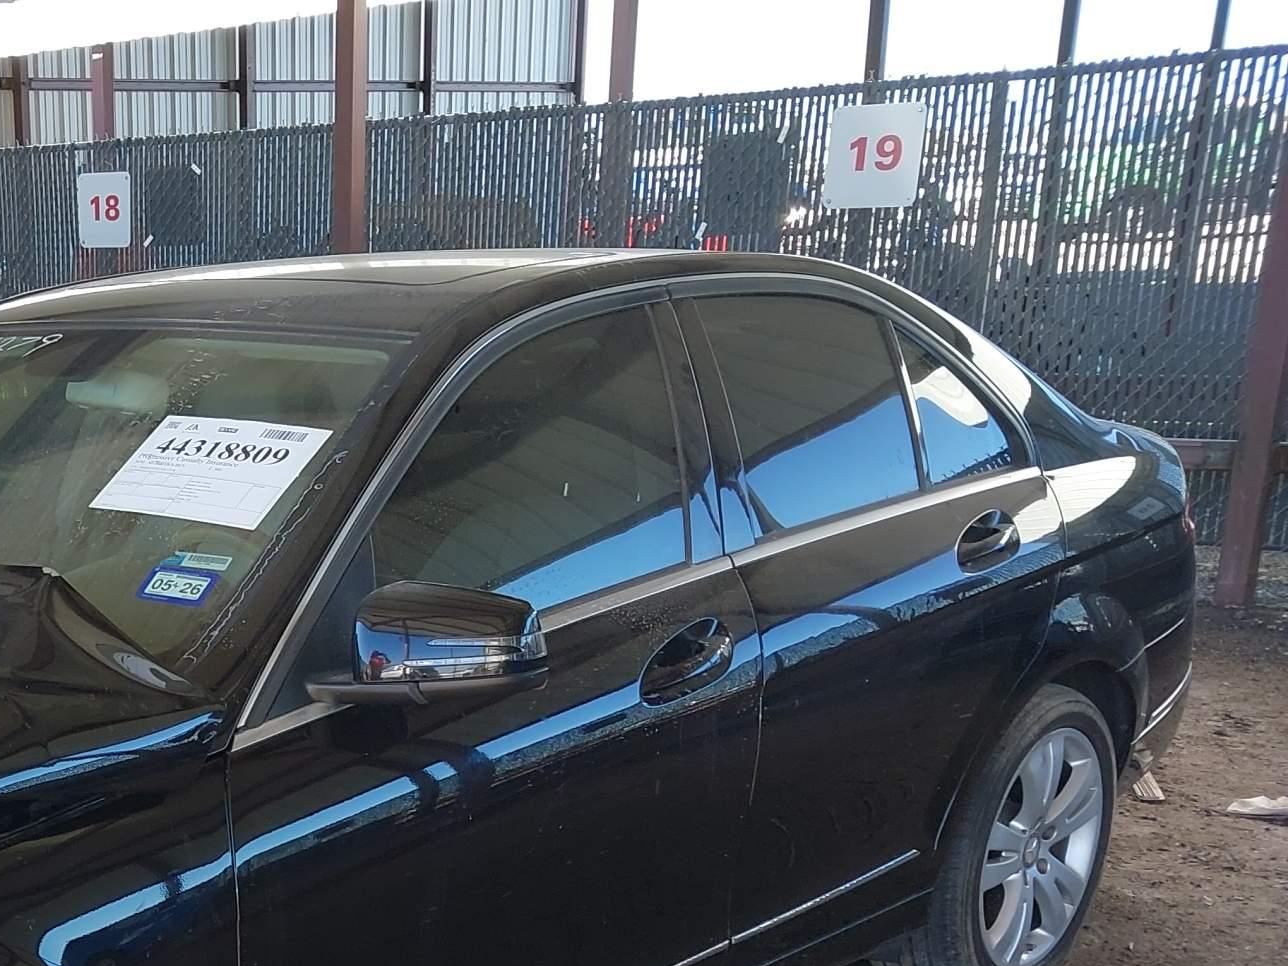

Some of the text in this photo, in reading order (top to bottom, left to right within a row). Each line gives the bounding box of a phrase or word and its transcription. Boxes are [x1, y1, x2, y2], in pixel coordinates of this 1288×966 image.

[849, 134, 903, 172] 19
[90, 194, 120, 221] 18
[156, 437, 291, 466] 44318809
[151, 578, 203, 595] 05 26
